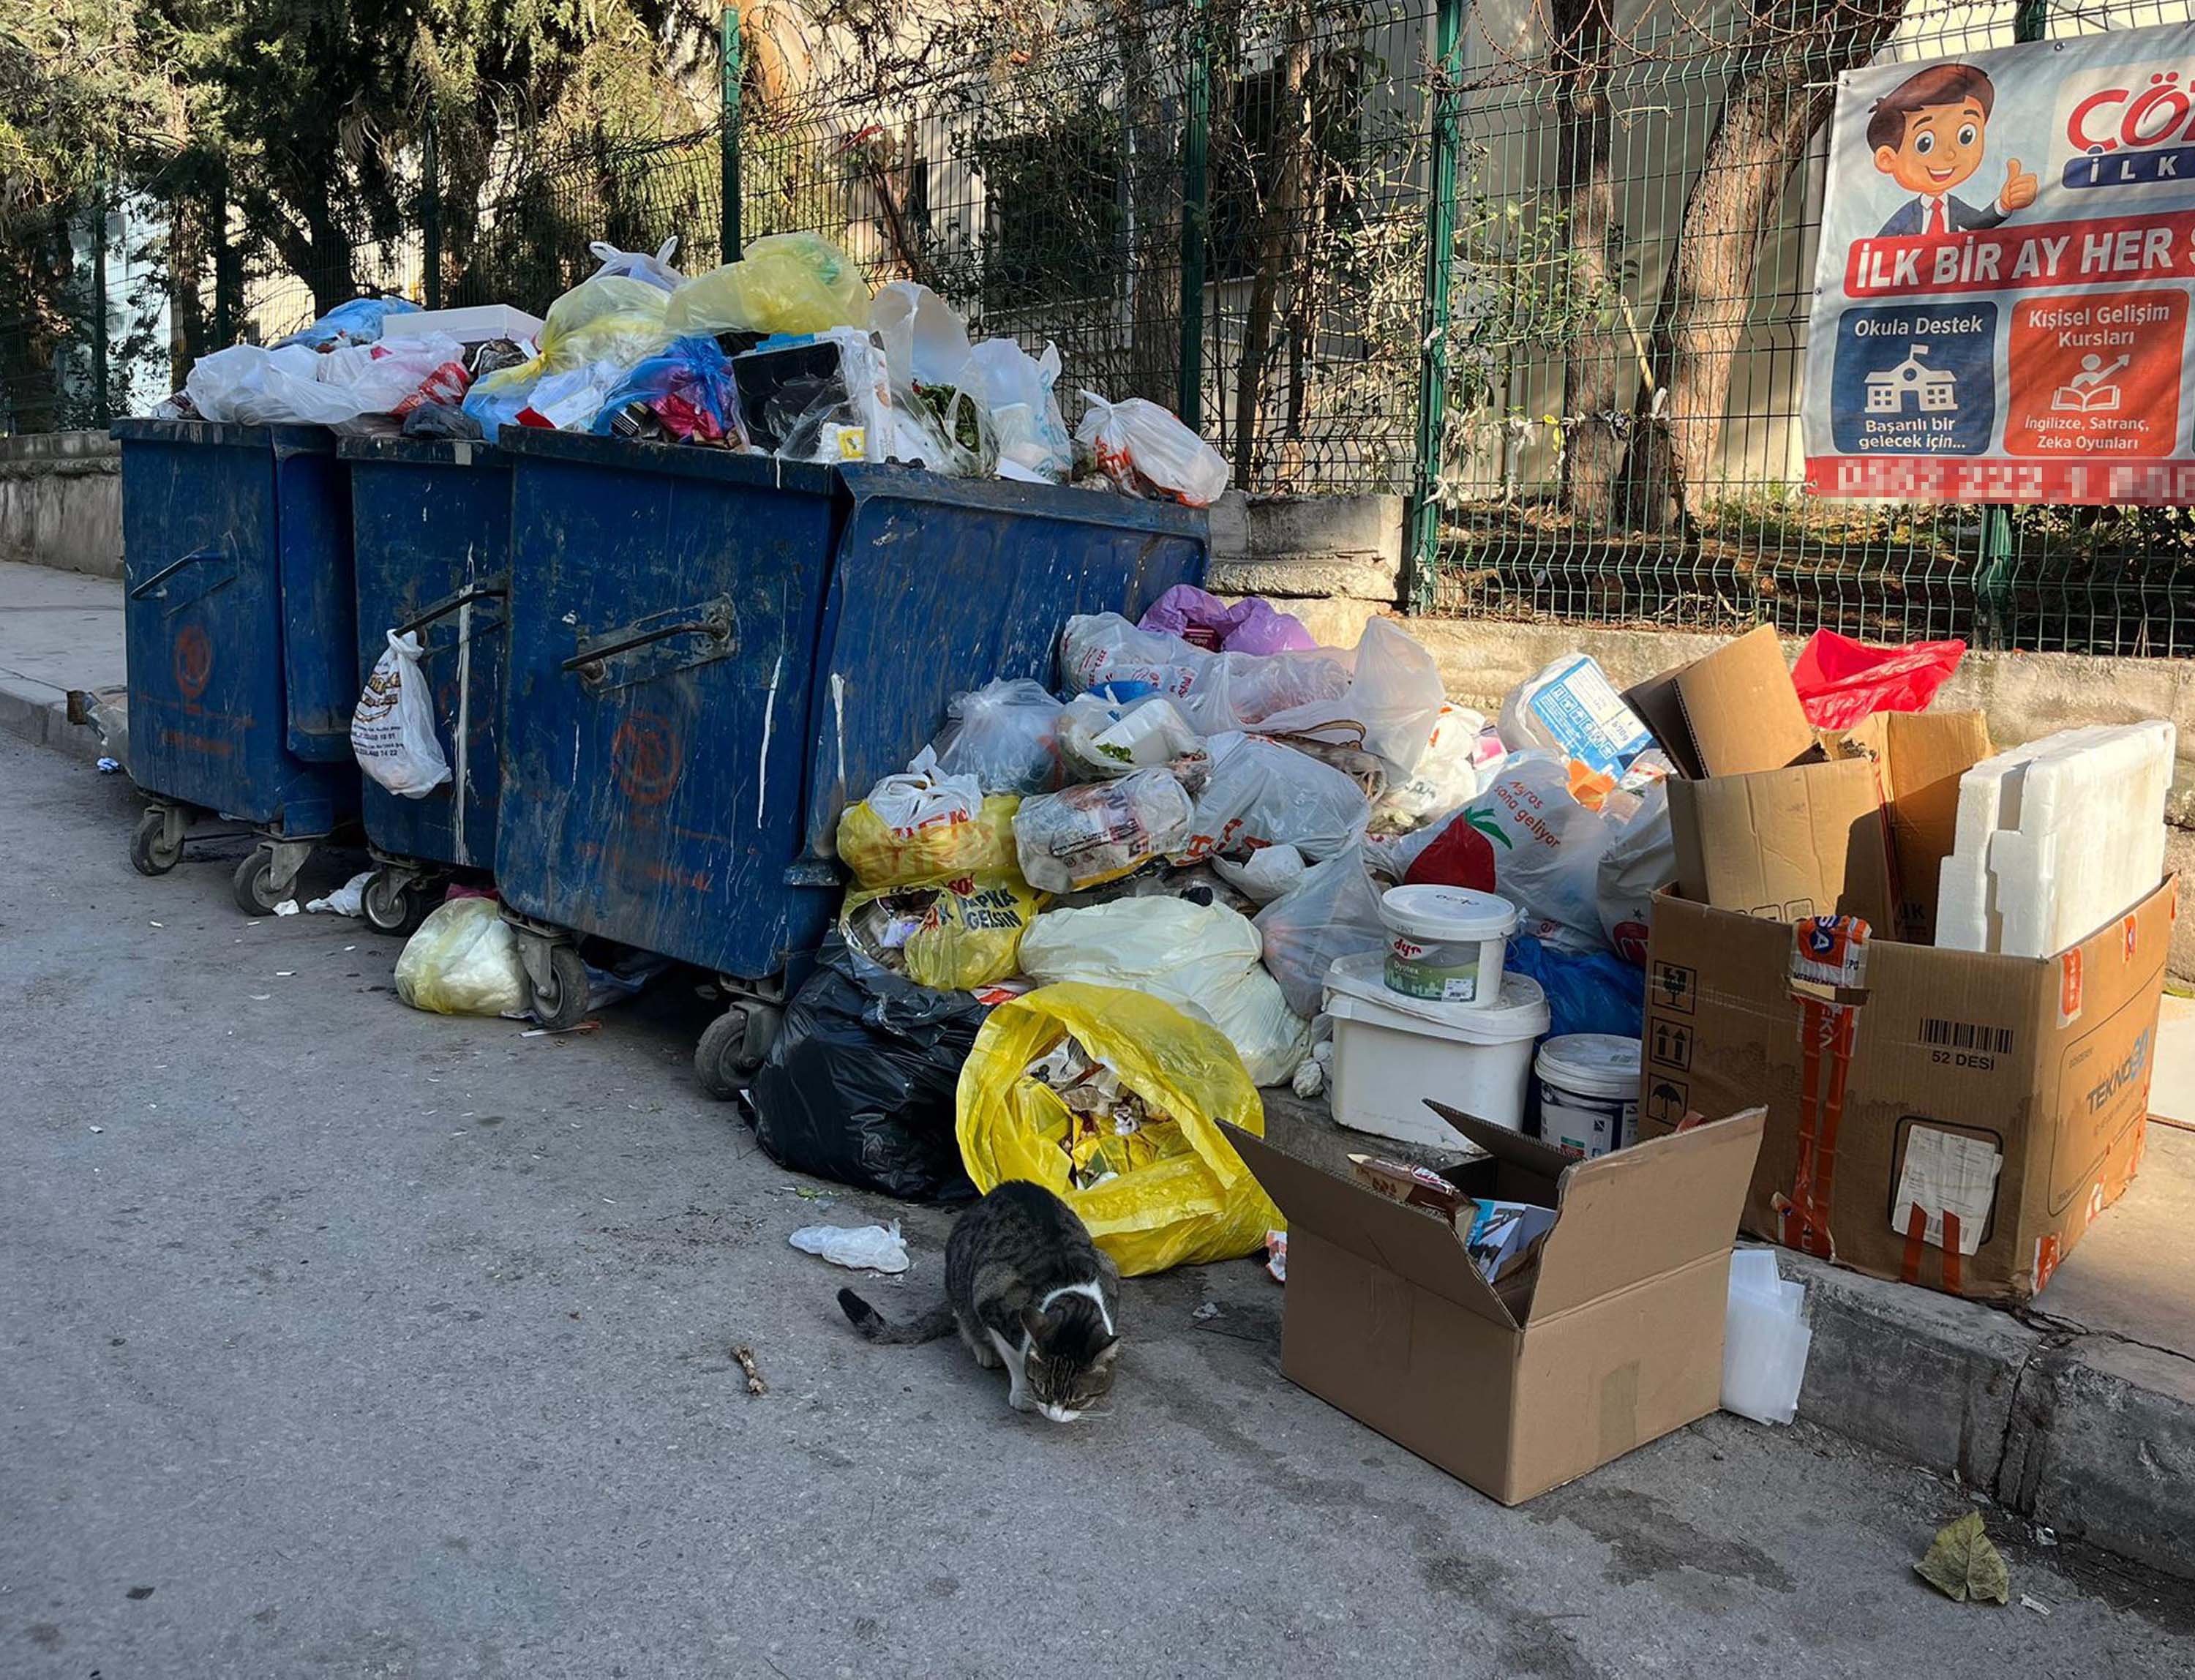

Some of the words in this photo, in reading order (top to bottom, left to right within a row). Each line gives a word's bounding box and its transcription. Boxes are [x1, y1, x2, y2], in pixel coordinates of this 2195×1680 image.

[2067, 71, 2195, 154] ÇÖ
[1856, 241, 1923, 288] İLK
[1932, 235, 2000, 283] BİR
[2011, 236, 2070, 279] AY
[2080, 227, 2174, 274] HER
[1855, 318, 1909, 337] Okula
[1915, 315, 1983, 335] Destek
[2029, 307, 2090, 330] Kişisel
[2096, 304, 2169, 326] Gelişim
[2058, 330, 2134, 348] Kursları
[1865, 419, 1927, 435] Başarılı
[1932, 417, 1955, 432] bir
[2090, 417, 2150, 432] Satranç,
[1858, 434, 1922, 450] gelecek
[1926, 433, 1966, 450] için...
[2037, 435, 2071, 450] Zeka
[2076, 435, 2139, 451] Oyunları
[1494, 785, 1519, 810] sana
[1514, 809, 1561, 847] geliyor
[1932, 1050, 1951, 1065] 52
[1956, 1054, 1995, 1070] DESİ
